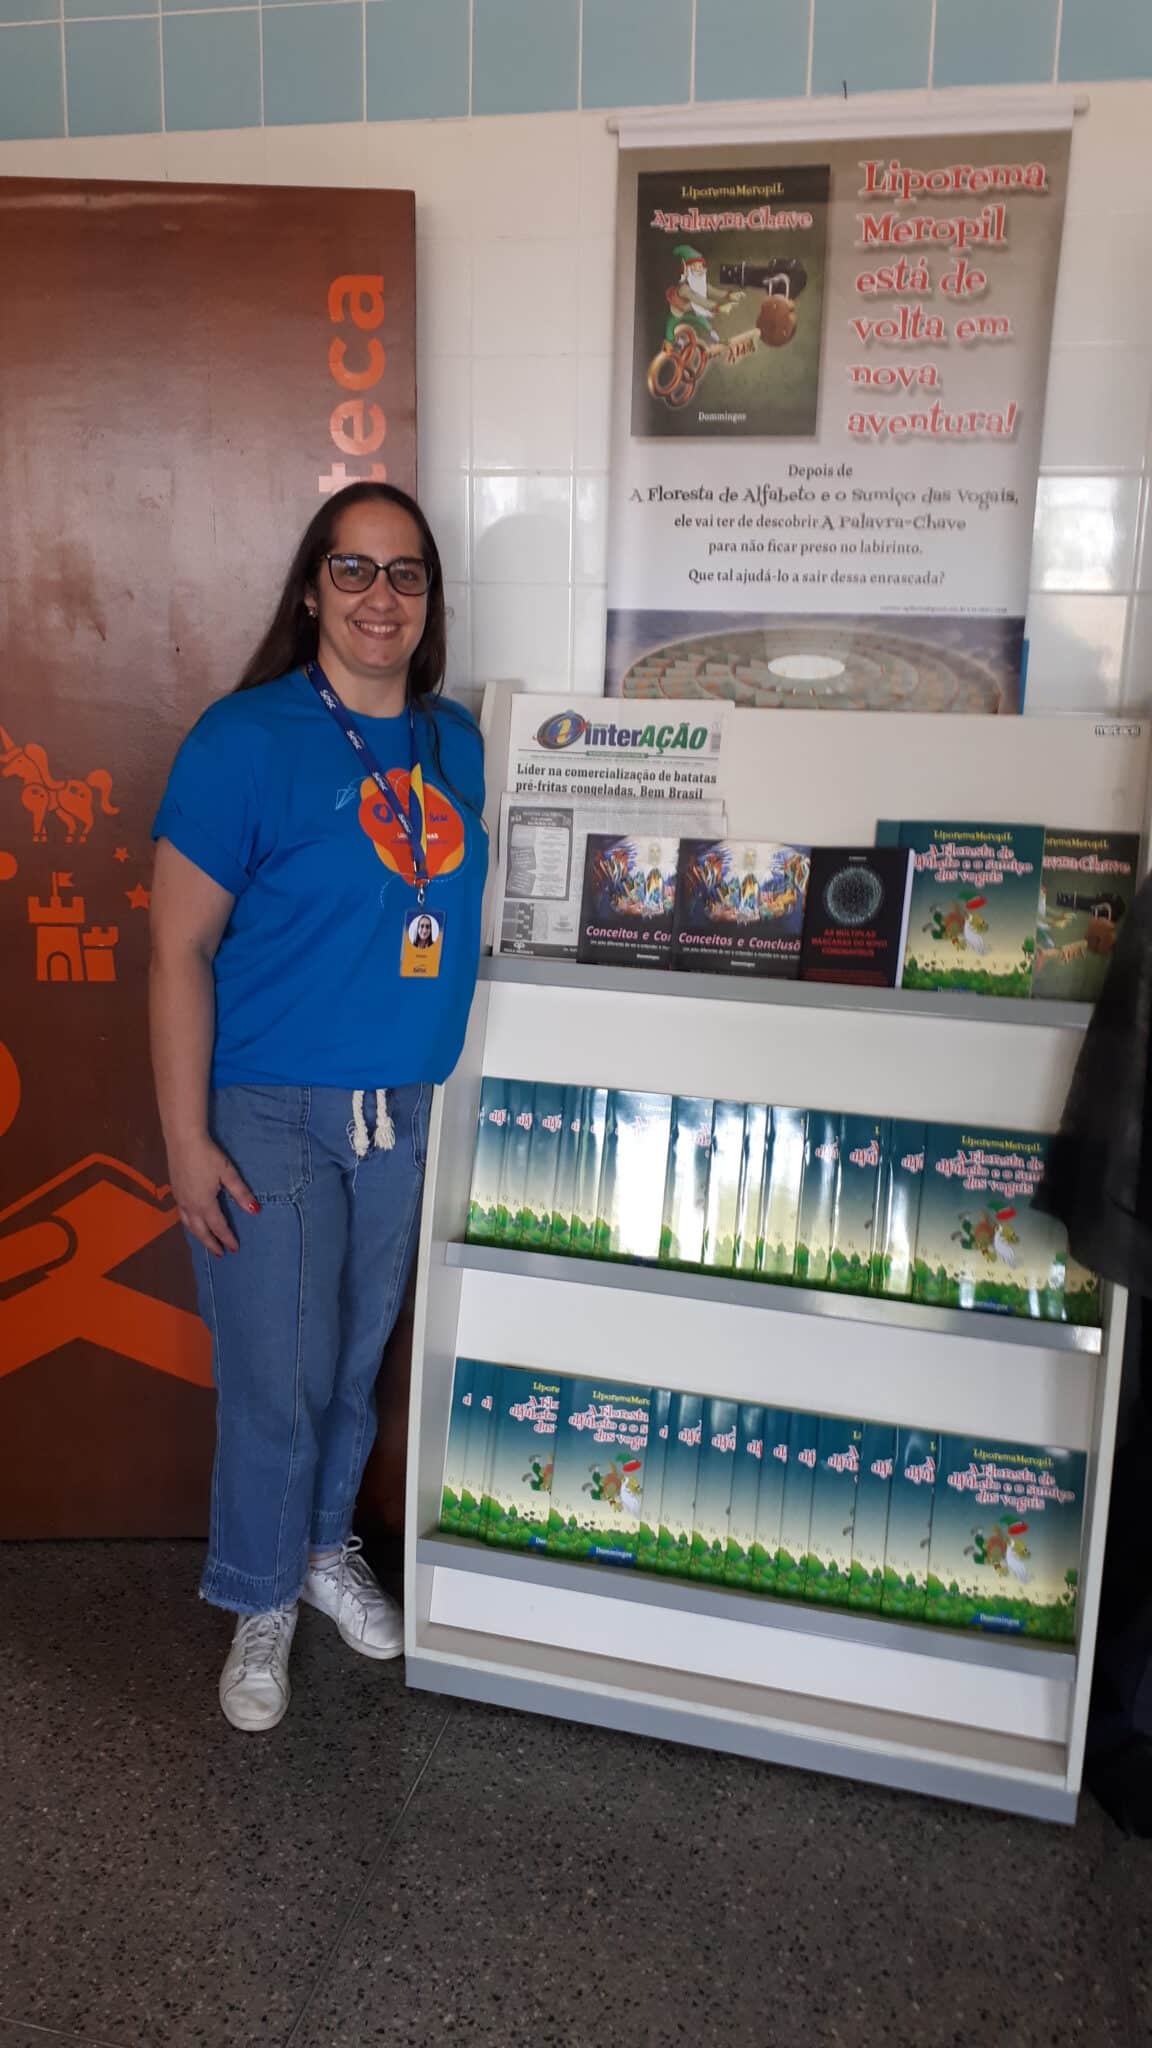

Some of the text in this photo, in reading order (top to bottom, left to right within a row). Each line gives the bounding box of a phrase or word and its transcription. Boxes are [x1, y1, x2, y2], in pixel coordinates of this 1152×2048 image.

[863, 160, 1047, 198] Liporema
[861, 206, 1006, 248] Meropil
[856, 257, 986, 294] está de
[850, 306, 1010, 343] volta em
[848, 364, 938, 388] nova
[847, 401, 1017, 434] aventura!
[788, 463, 853, 480] Depois de
[631, 488, 643, 502] A
[648, 484, 713, 502] Floresta
[743, 483, 816, 506] Alfabeto
[821, 491, 830, 502] e
[835, 491, 847, 501] o
[851, 487, 916, 506] Sumiço
[921, 487, 951, 503] das
[674, 512, 966, 531] ele vai ter de descobrir A Palavra-Chave
[708, 539, 923, 556] para não ficar preso no labirinto.
[688, 568, 945, 585] Que tal ajudá-lo a sair dessa enrascada?
[584, 722, 708, 754] interAÇÃO
[517, 763, 717, 784] Líder na comercialização de batatas
[515, 780, 567, 794] pré-fritas
[640, 786, 665, 799] Bem
[668, 786, 703, 800] Brasil
[586, 925, 638, 940] Conceitos
[642, 931, 650, 940] e
[679, 932, 732, 946] Conceitos
[737, 938, 745, 947] e
